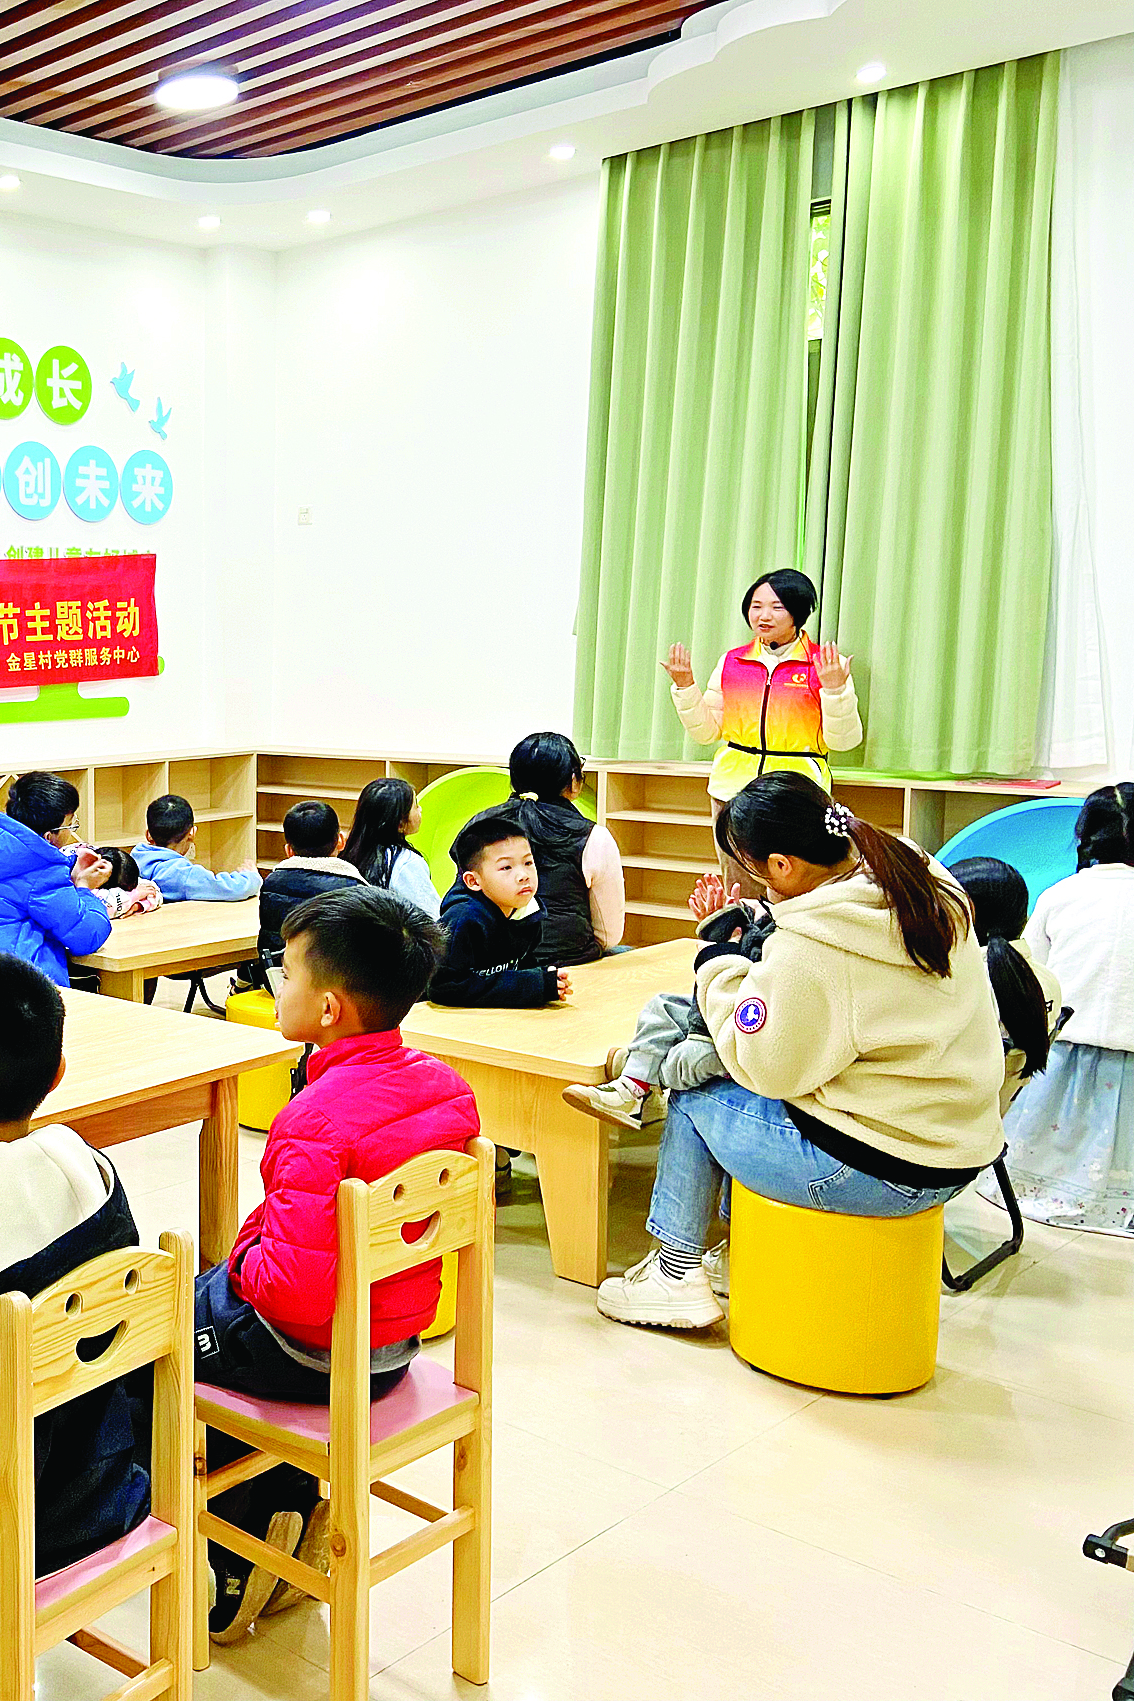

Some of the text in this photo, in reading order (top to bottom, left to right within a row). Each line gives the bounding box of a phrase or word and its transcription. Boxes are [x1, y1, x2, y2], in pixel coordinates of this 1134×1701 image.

[6, 645, 141, 673] 金星村党群服务中心
